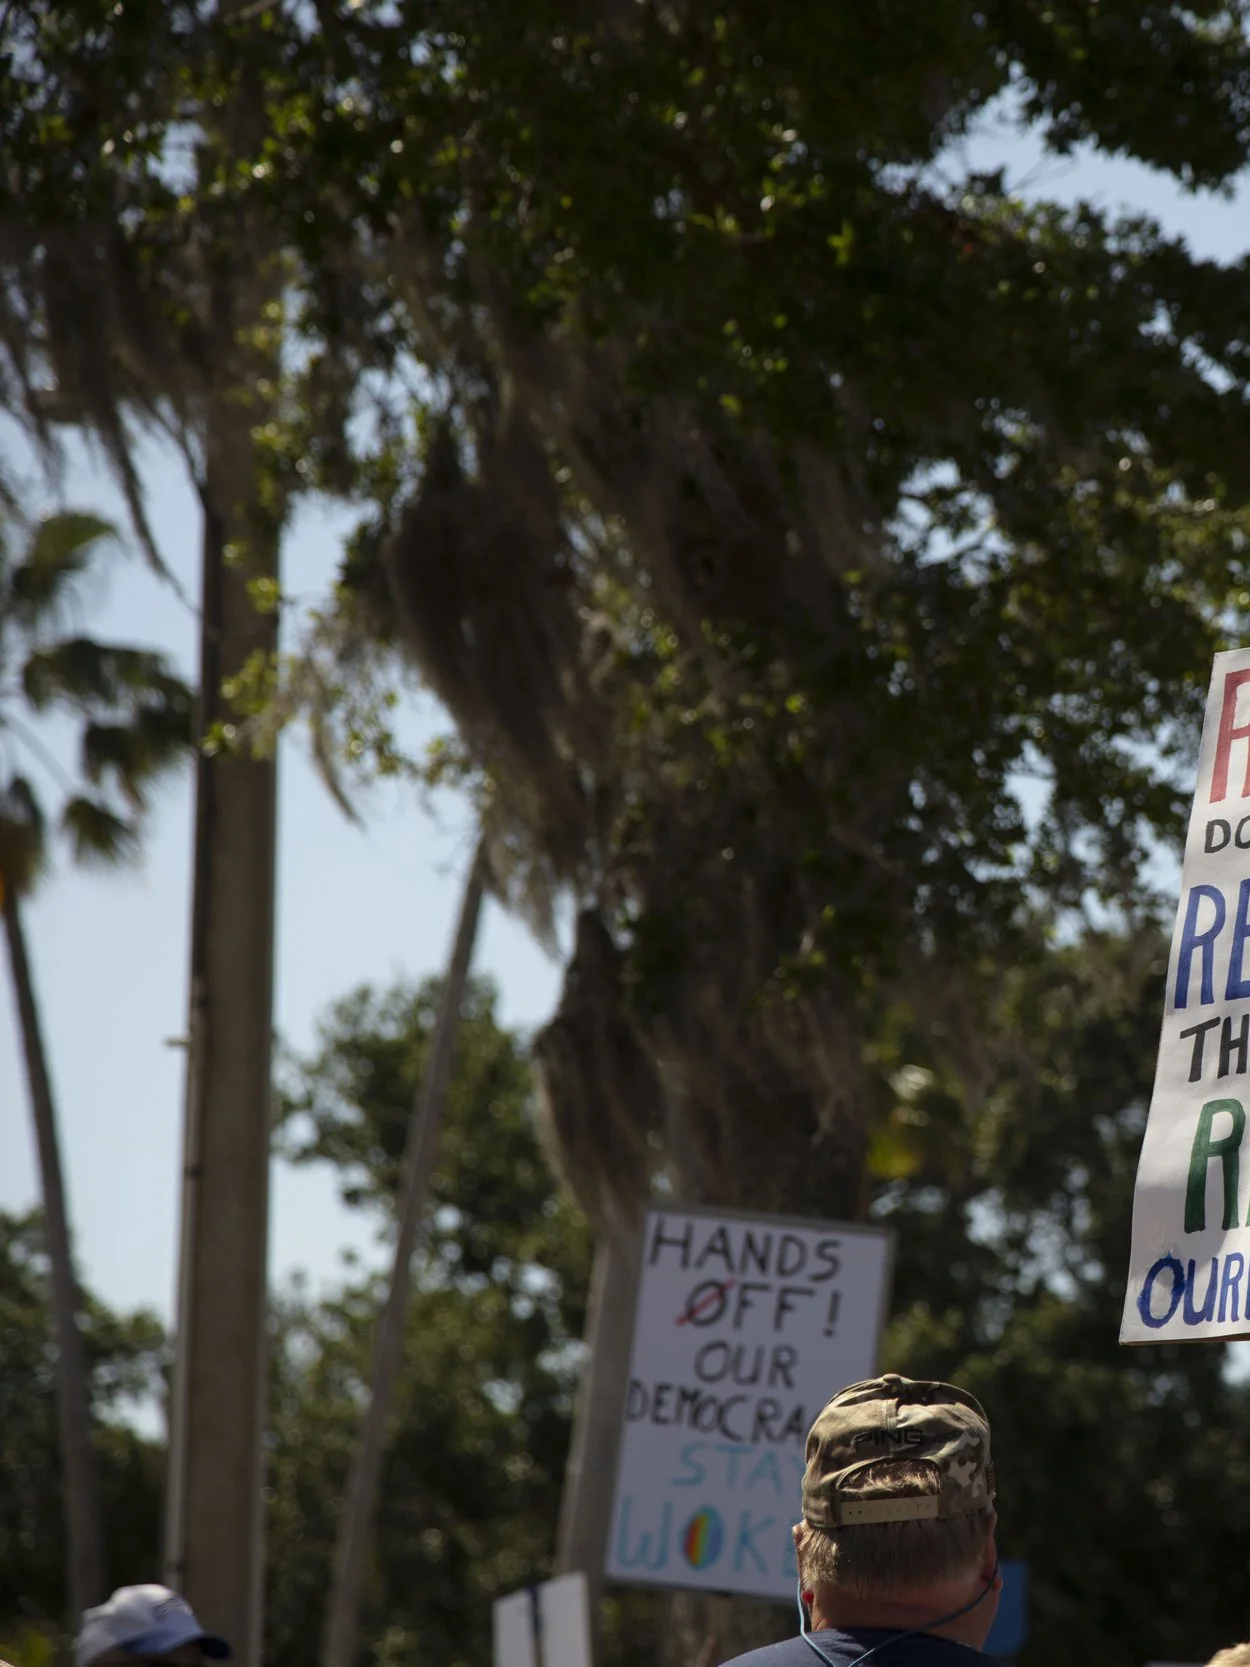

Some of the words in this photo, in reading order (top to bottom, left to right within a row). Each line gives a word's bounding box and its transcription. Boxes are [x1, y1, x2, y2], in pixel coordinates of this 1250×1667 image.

[649, 1215, 842, 1282] HANDS
[694, 1339, 798, 1390] OUR
[626, 1379, 815, 1445] DEMOCRA
[854, 1428, 924, 1451] PING
